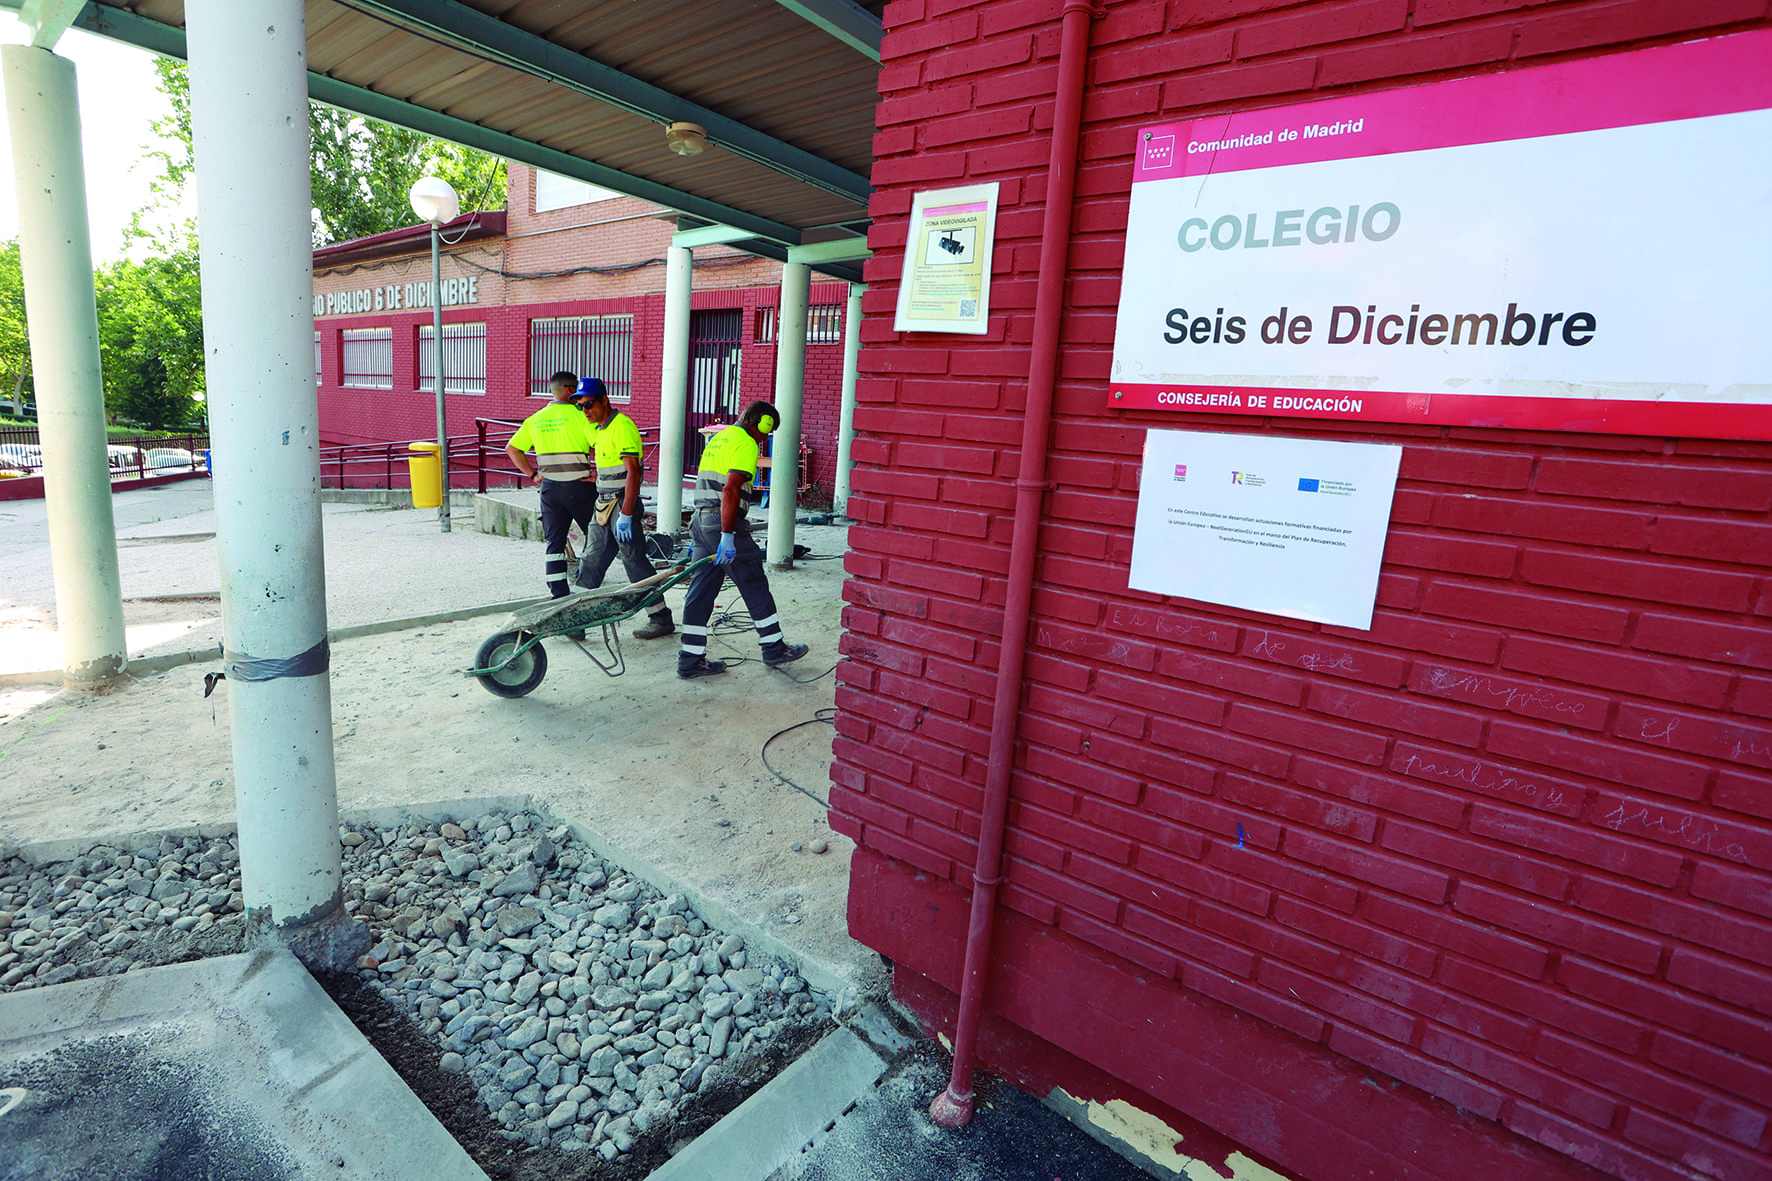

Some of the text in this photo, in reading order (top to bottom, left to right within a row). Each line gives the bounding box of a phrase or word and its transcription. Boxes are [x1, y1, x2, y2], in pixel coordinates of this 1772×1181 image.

[1187, 118, 1364, 154] Comunidad de Madrid
[1177, 201, 1402, 253] COLEGIO
[327, 289, 372, 315] PUBLICO
[375, 287, 386, 310] 6
[387, 285, 403, 309] DE
[1164, 303, 1598, 347] Seis de Diciembre
[1157, 391, 1363, 414] CONSEJERÍA DE EDUCACIÓN
